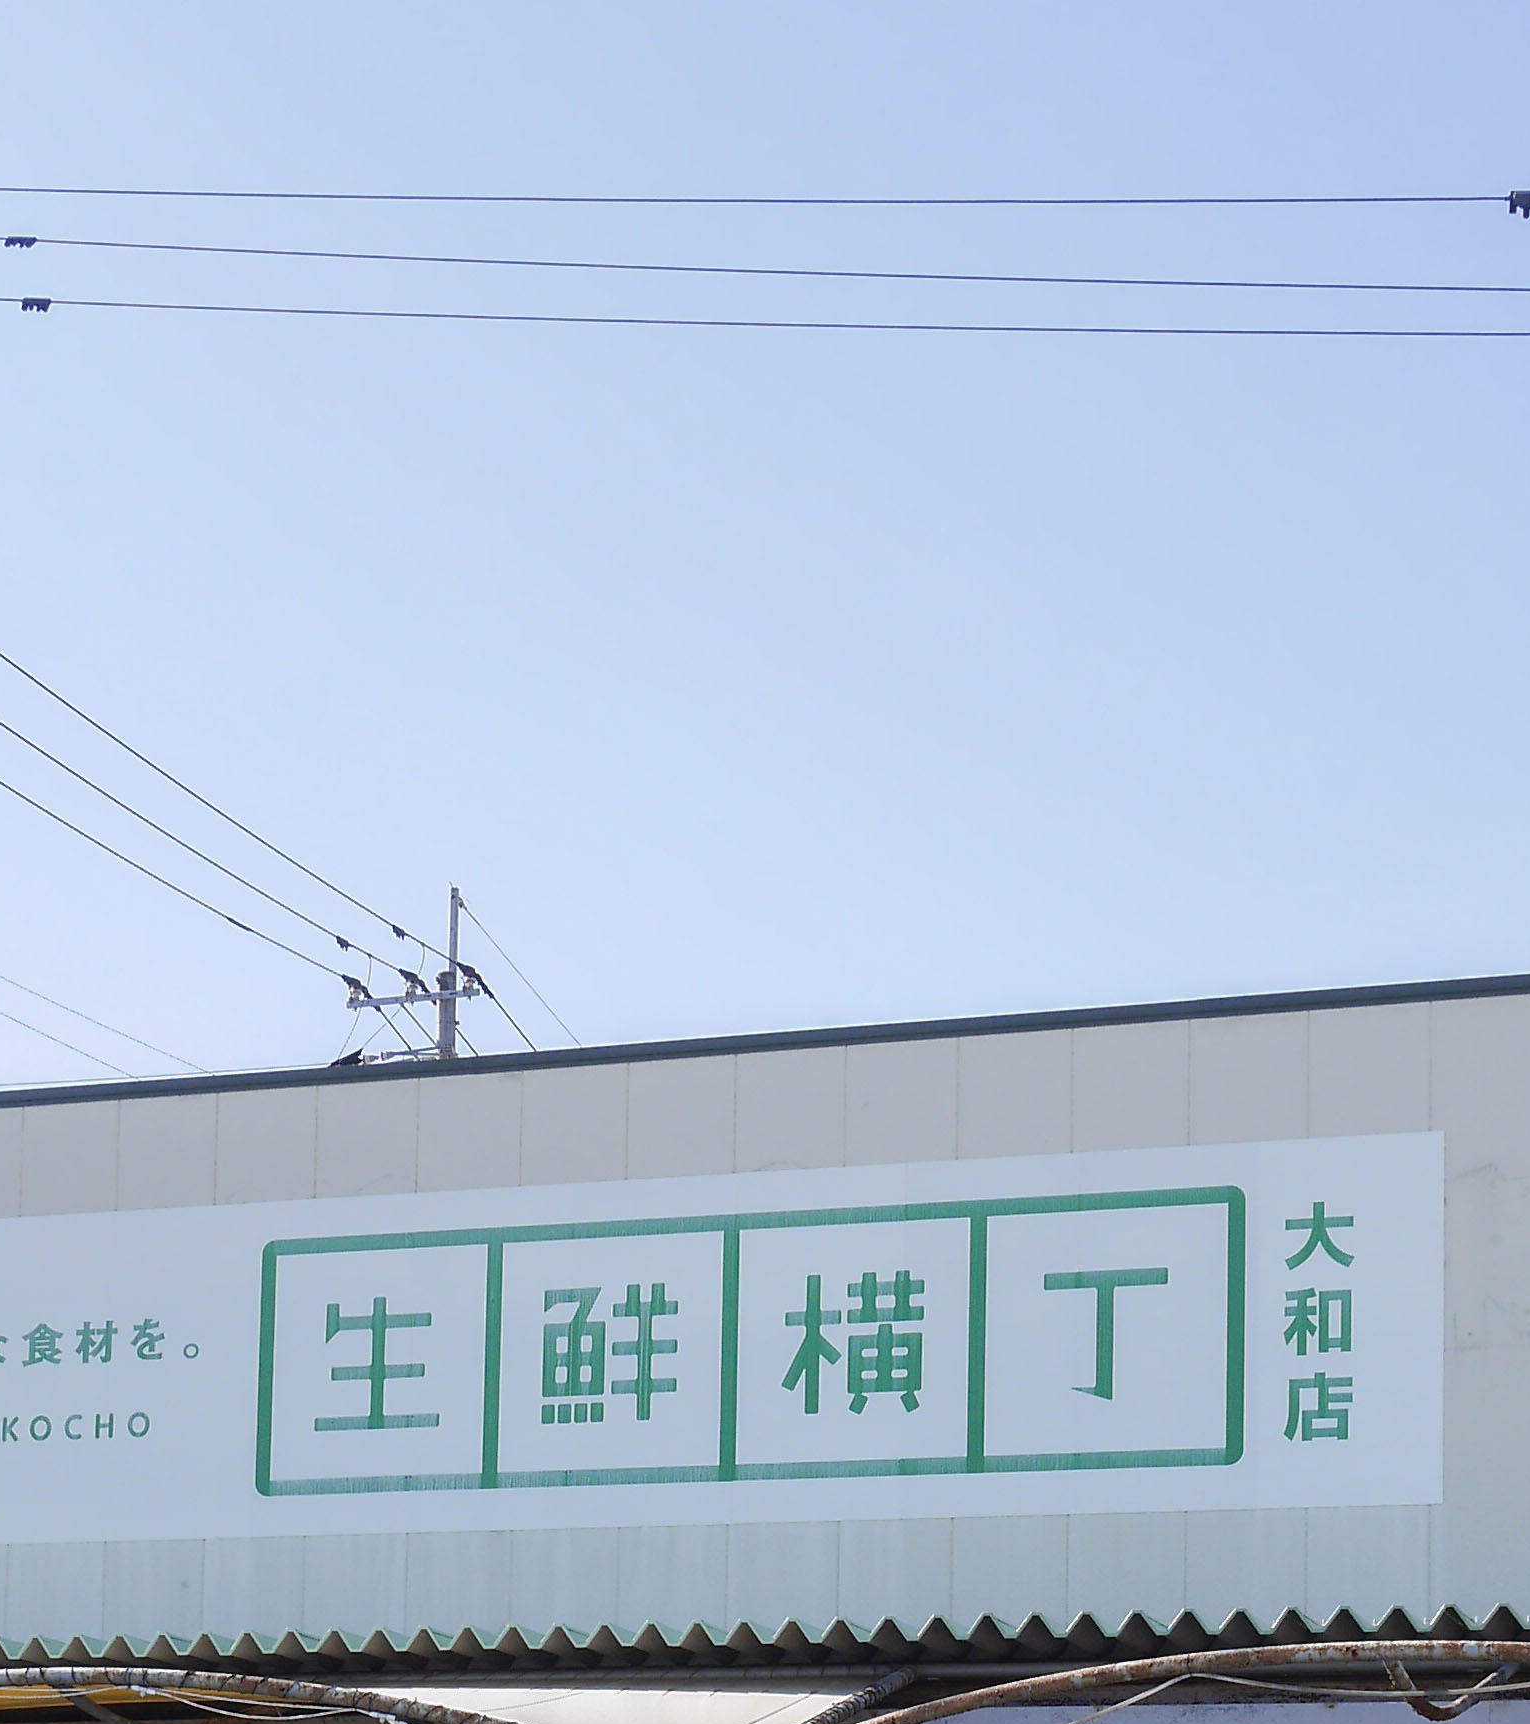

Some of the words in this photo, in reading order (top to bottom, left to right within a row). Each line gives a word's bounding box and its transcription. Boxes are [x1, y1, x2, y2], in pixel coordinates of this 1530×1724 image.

[313, 1265, 1170, 1433] 生鮮横丁
[1281, 1200, 1356, 1442] 大和店
